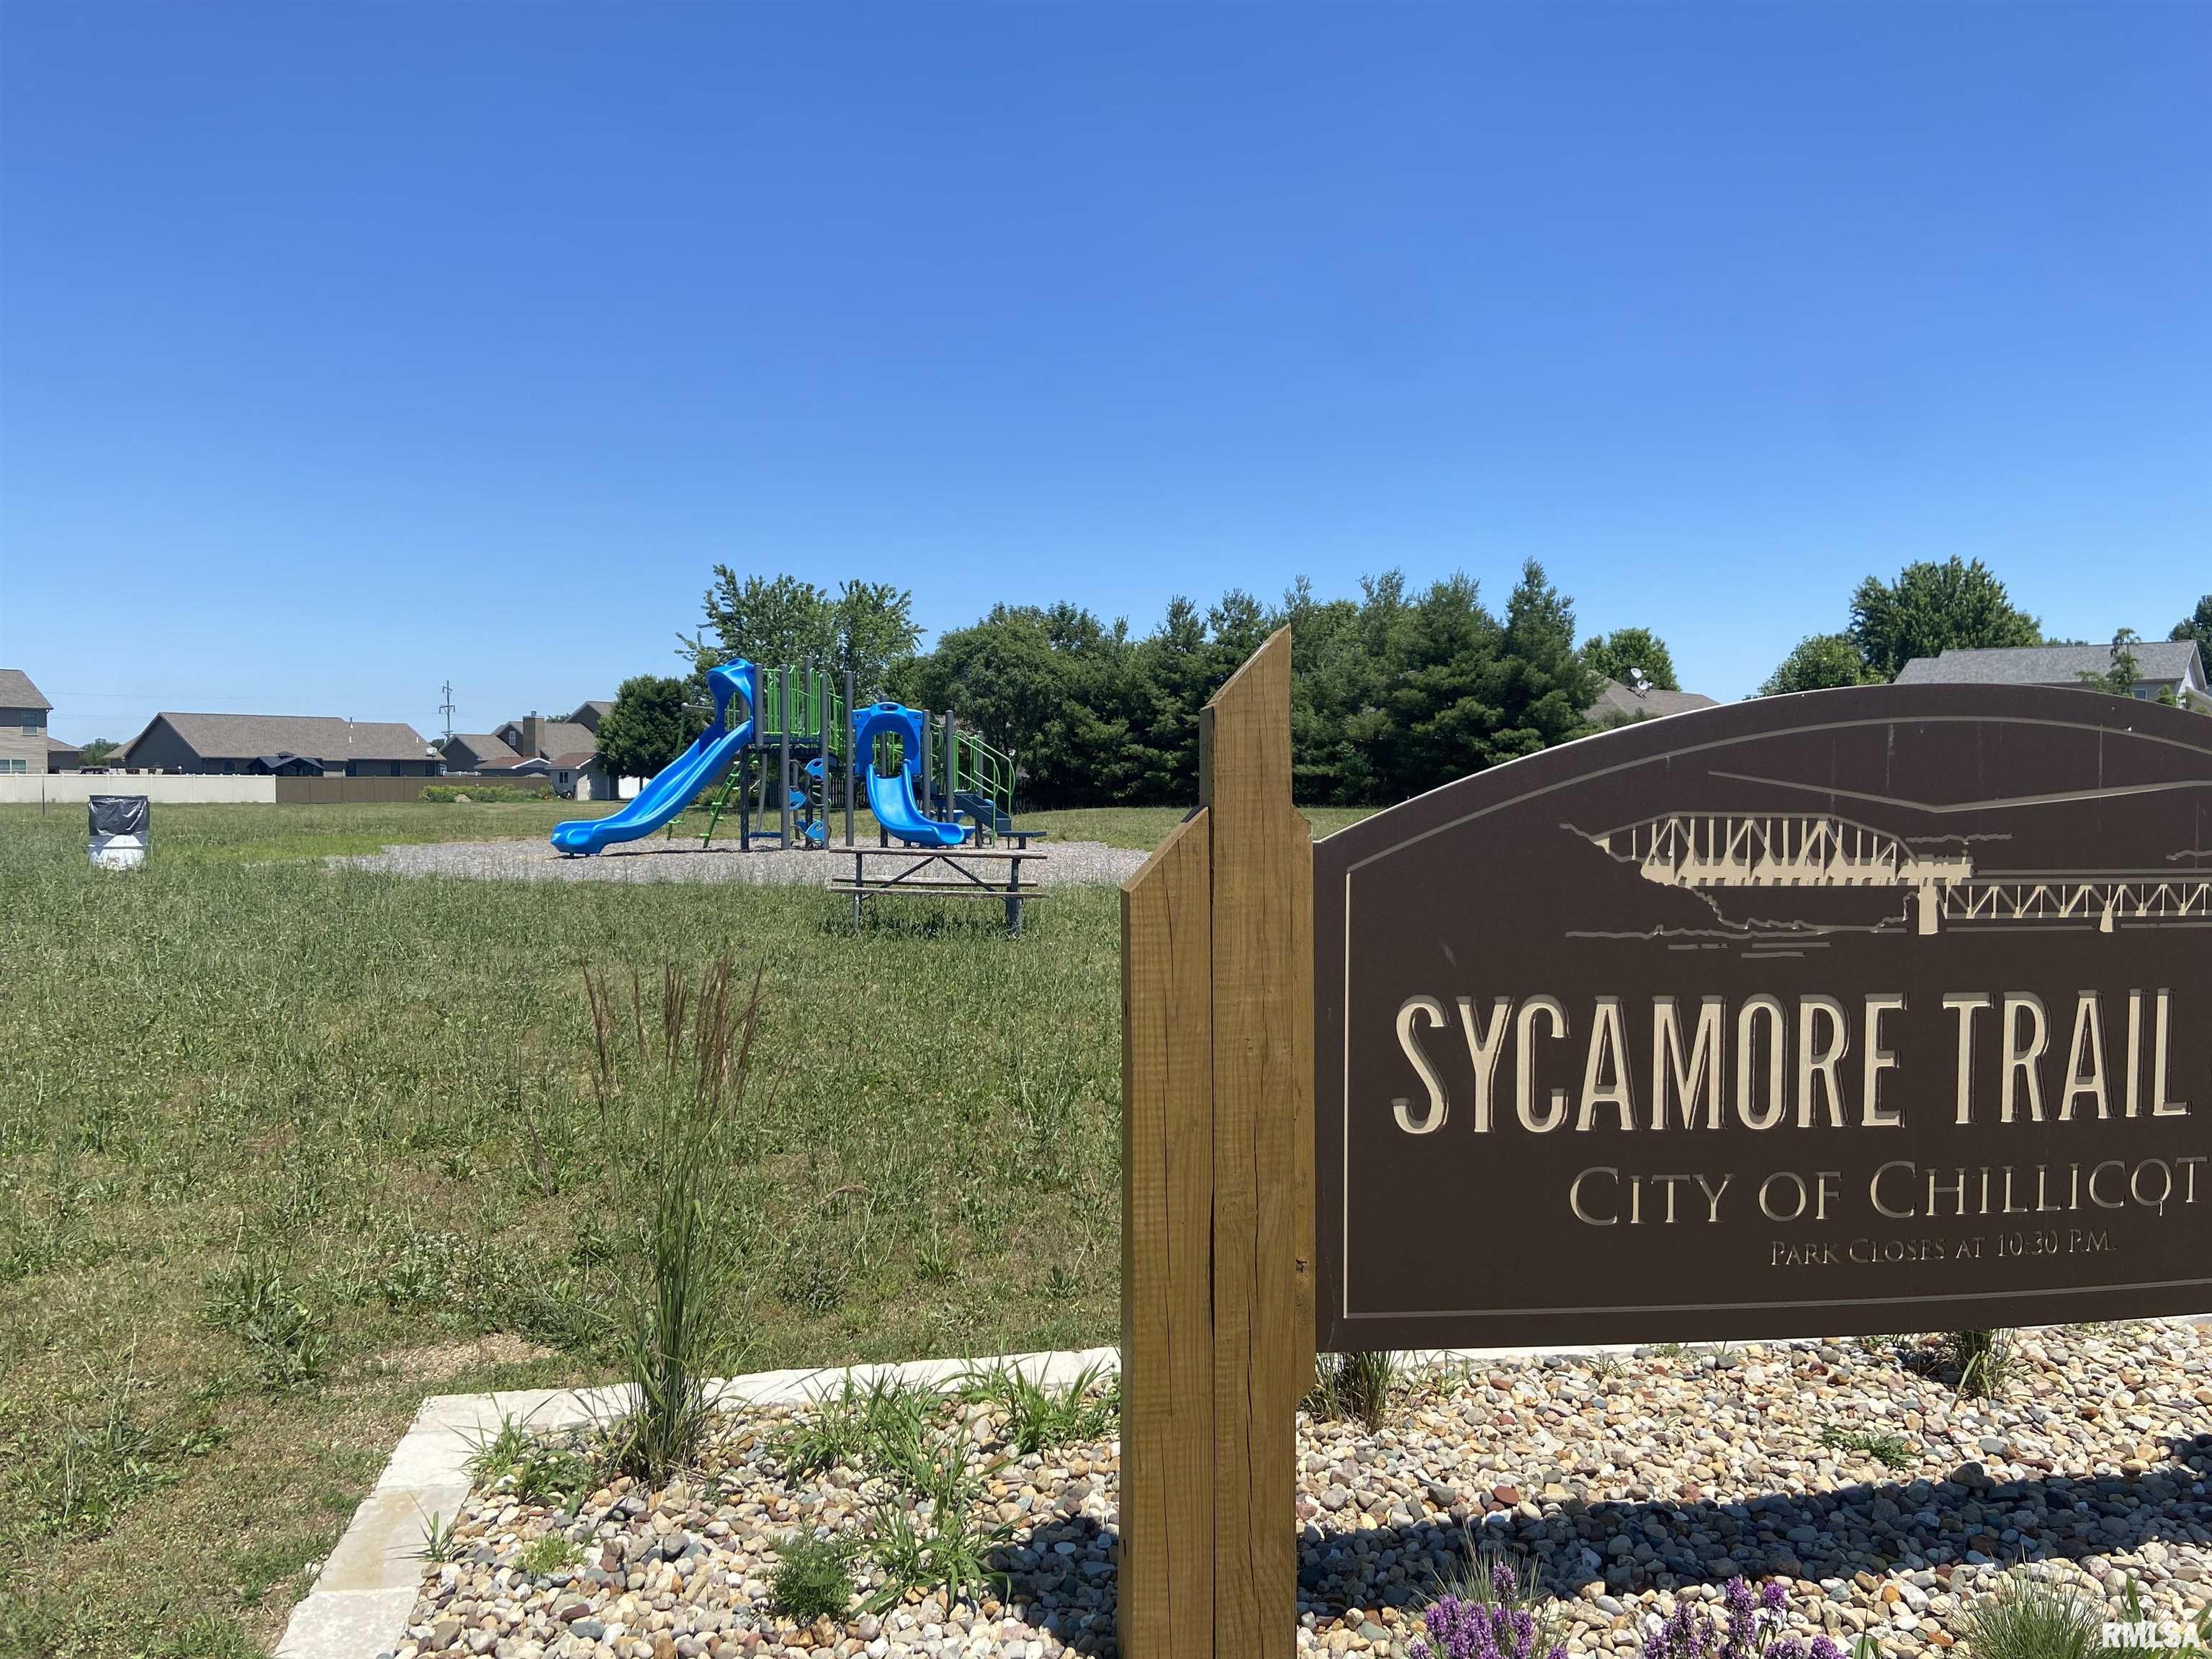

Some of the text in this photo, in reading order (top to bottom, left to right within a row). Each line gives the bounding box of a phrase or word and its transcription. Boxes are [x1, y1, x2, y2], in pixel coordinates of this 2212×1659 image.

[1390, 987, 2193, 1133] SYCAMORE TRAIL
[1758, 1169, 1843, 1223] OF
